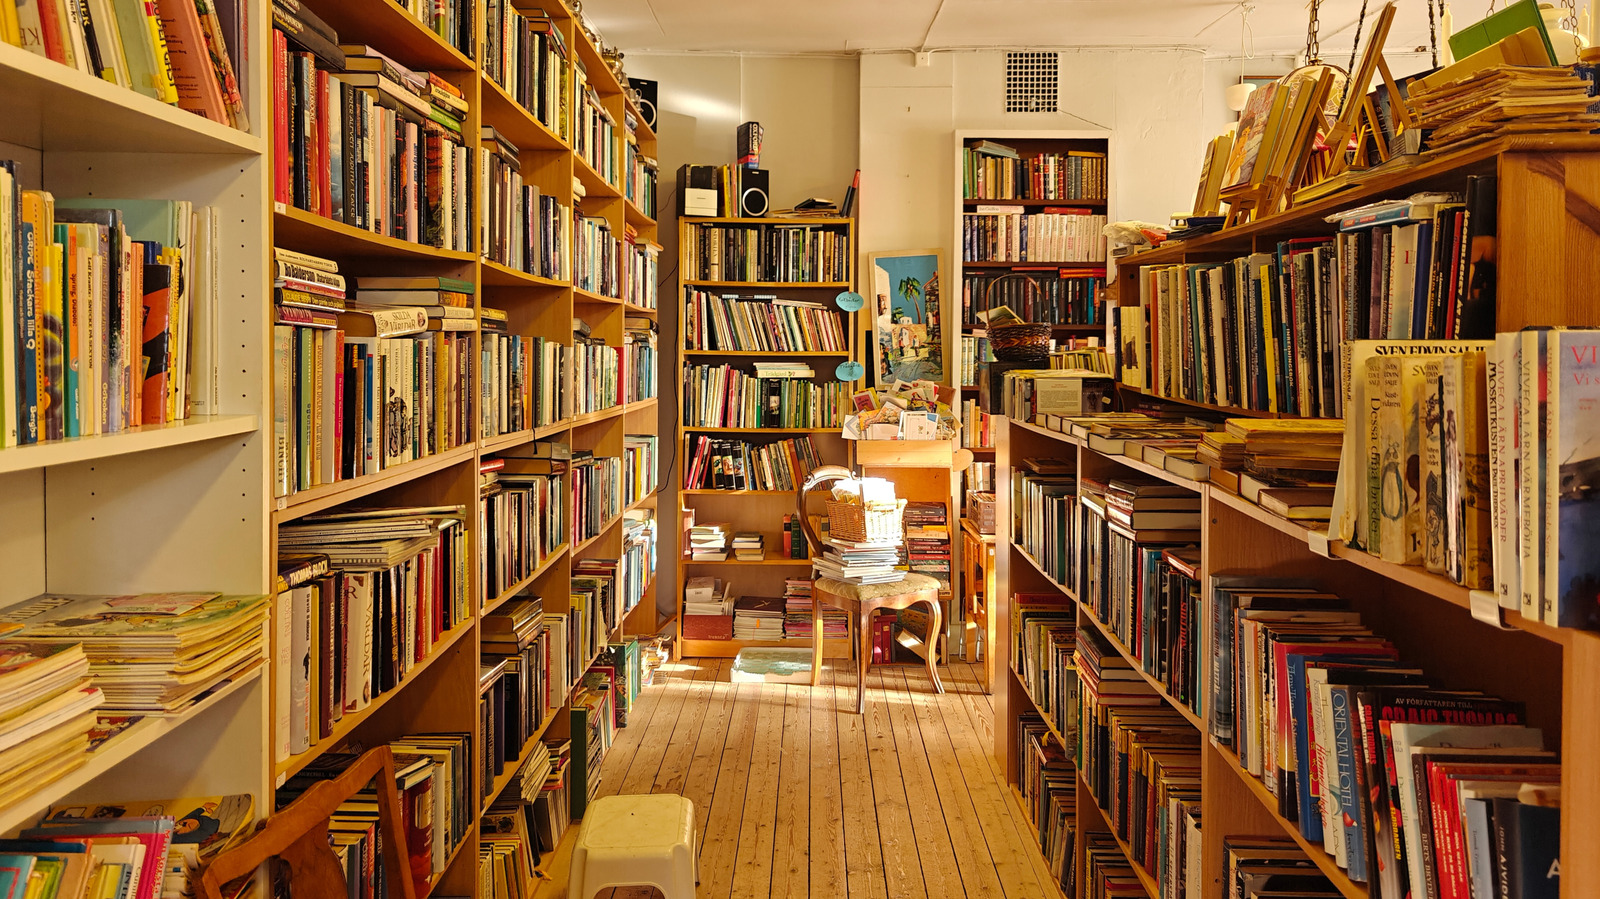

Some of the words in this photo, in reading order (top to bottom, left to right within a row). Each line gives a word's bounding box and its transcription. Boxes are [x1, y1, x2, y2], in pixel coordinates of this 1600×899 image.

[284, 262, 292, 278] Bo
[291, 264, 315, 283] Balderson
[27, 269, 35, 316] Stackars
[391, 310, 411, 320] SKILDA
[26, 338, 36, 350] Q
[1497, 360, 1506, 415] VIVECA
[1522, 361, 1531, 416] VIVECA
[29, 405, 37, 438] Berghs
[1370, 397, 1381, 442] Dessa
[1487, 361, 1499, 465] MOSKITKUSTEN
[289, 565, 311, 587] THOMAS
[311, 559, 328, 579] BLOCK
[1364, 704, 1374, 731] CRAIG
[1395, 697, 1404, 705] AV
[1332, 693, 1348, 760] ORIENTAL
[1366, 730, 1377, 765] THOMAS
[1336, 763, 1352, 808] HOTEL
